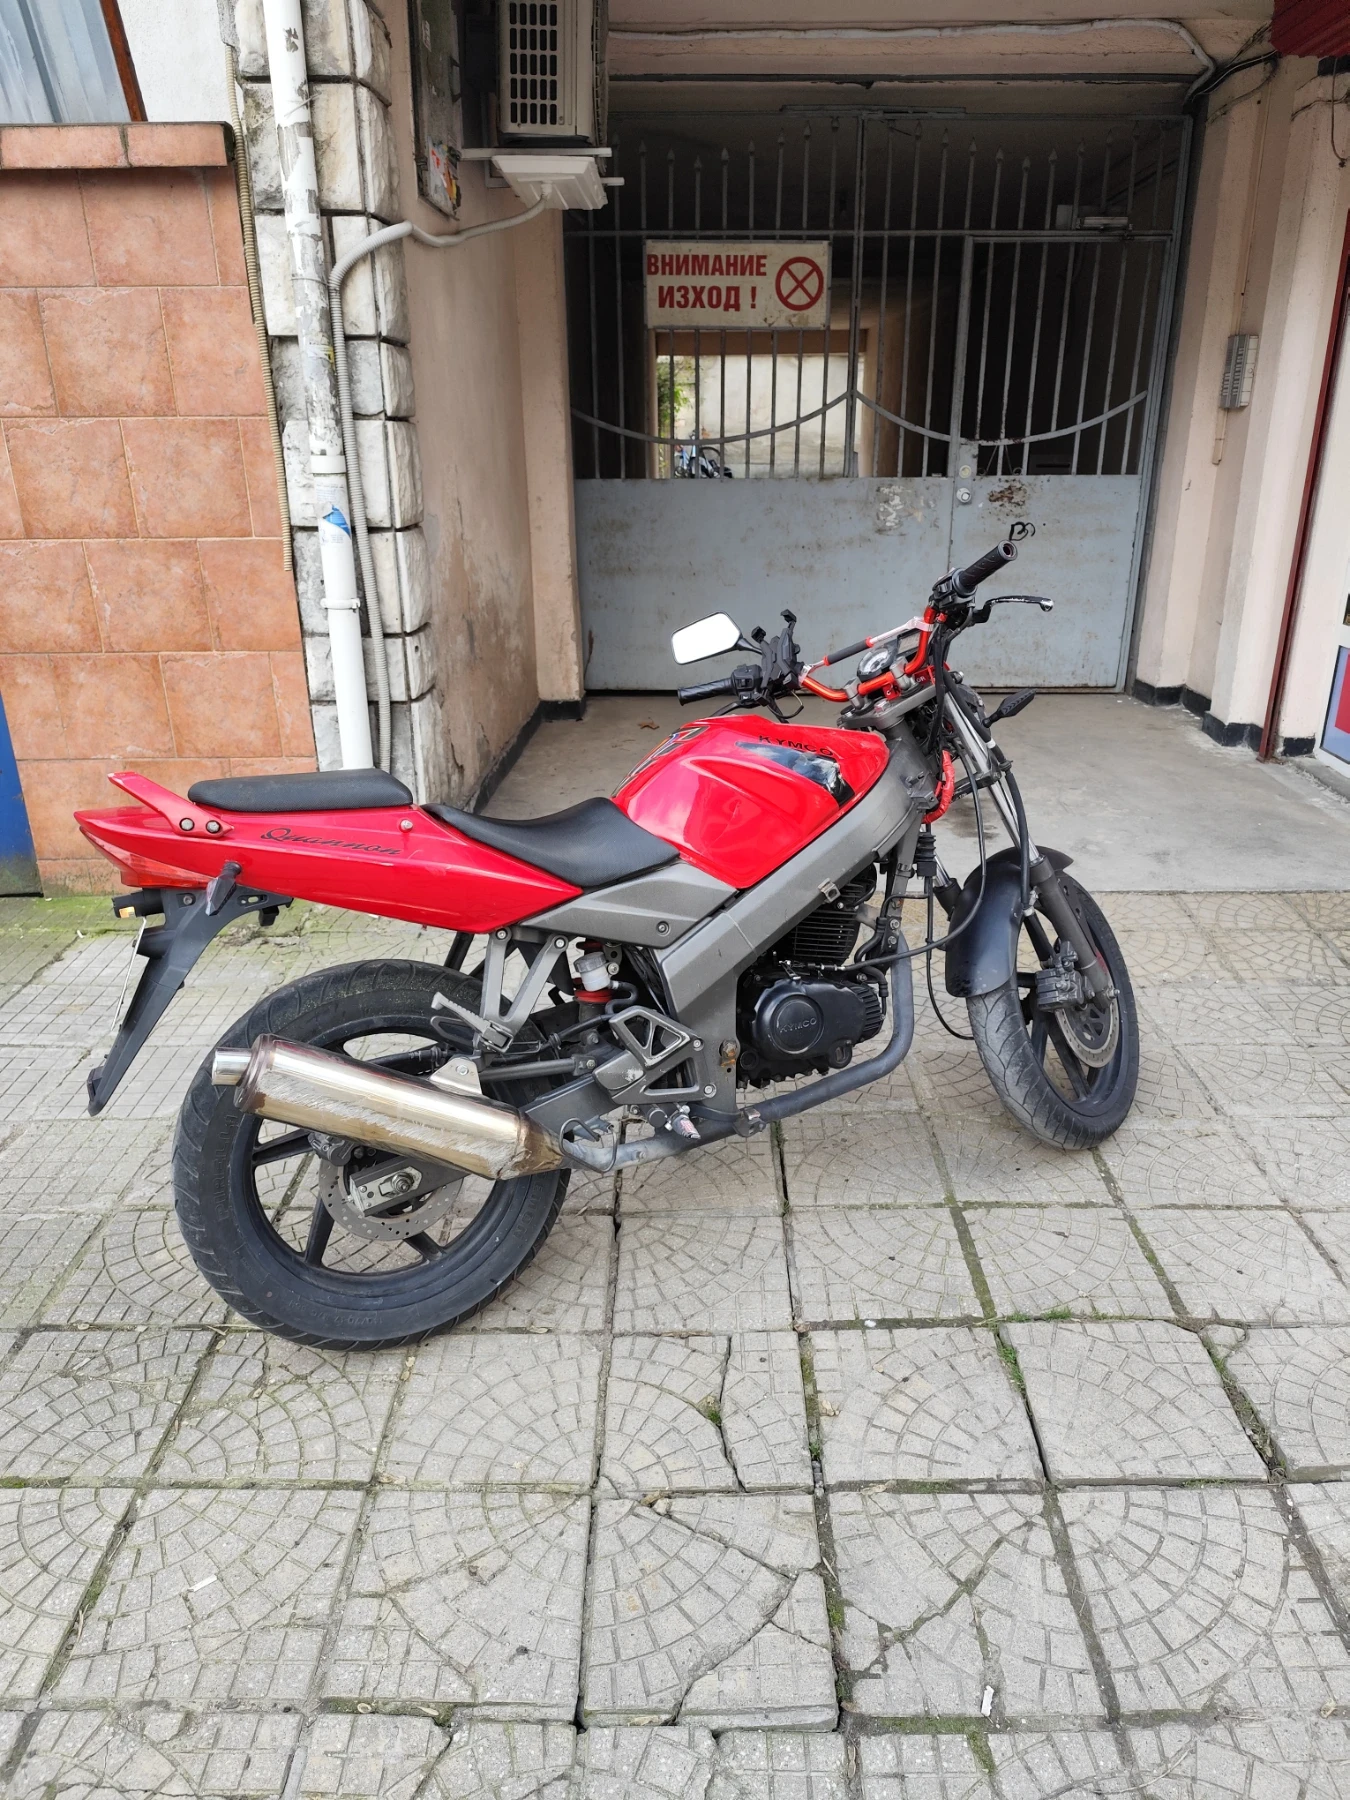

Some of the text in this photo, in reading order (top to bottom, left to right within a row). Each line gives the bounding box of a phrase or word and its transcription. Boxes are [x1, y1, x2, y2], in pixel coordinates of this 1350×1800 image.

[646, 254, 767, 277] ВНИМАНИЕ
[658, 285, 741, 312] ИЗХОД
[758, 735, 834, 757] KYMCO
[260, 827, 402, 855] Quannon
[213, 1113, 240, 1222] PIRELLI
